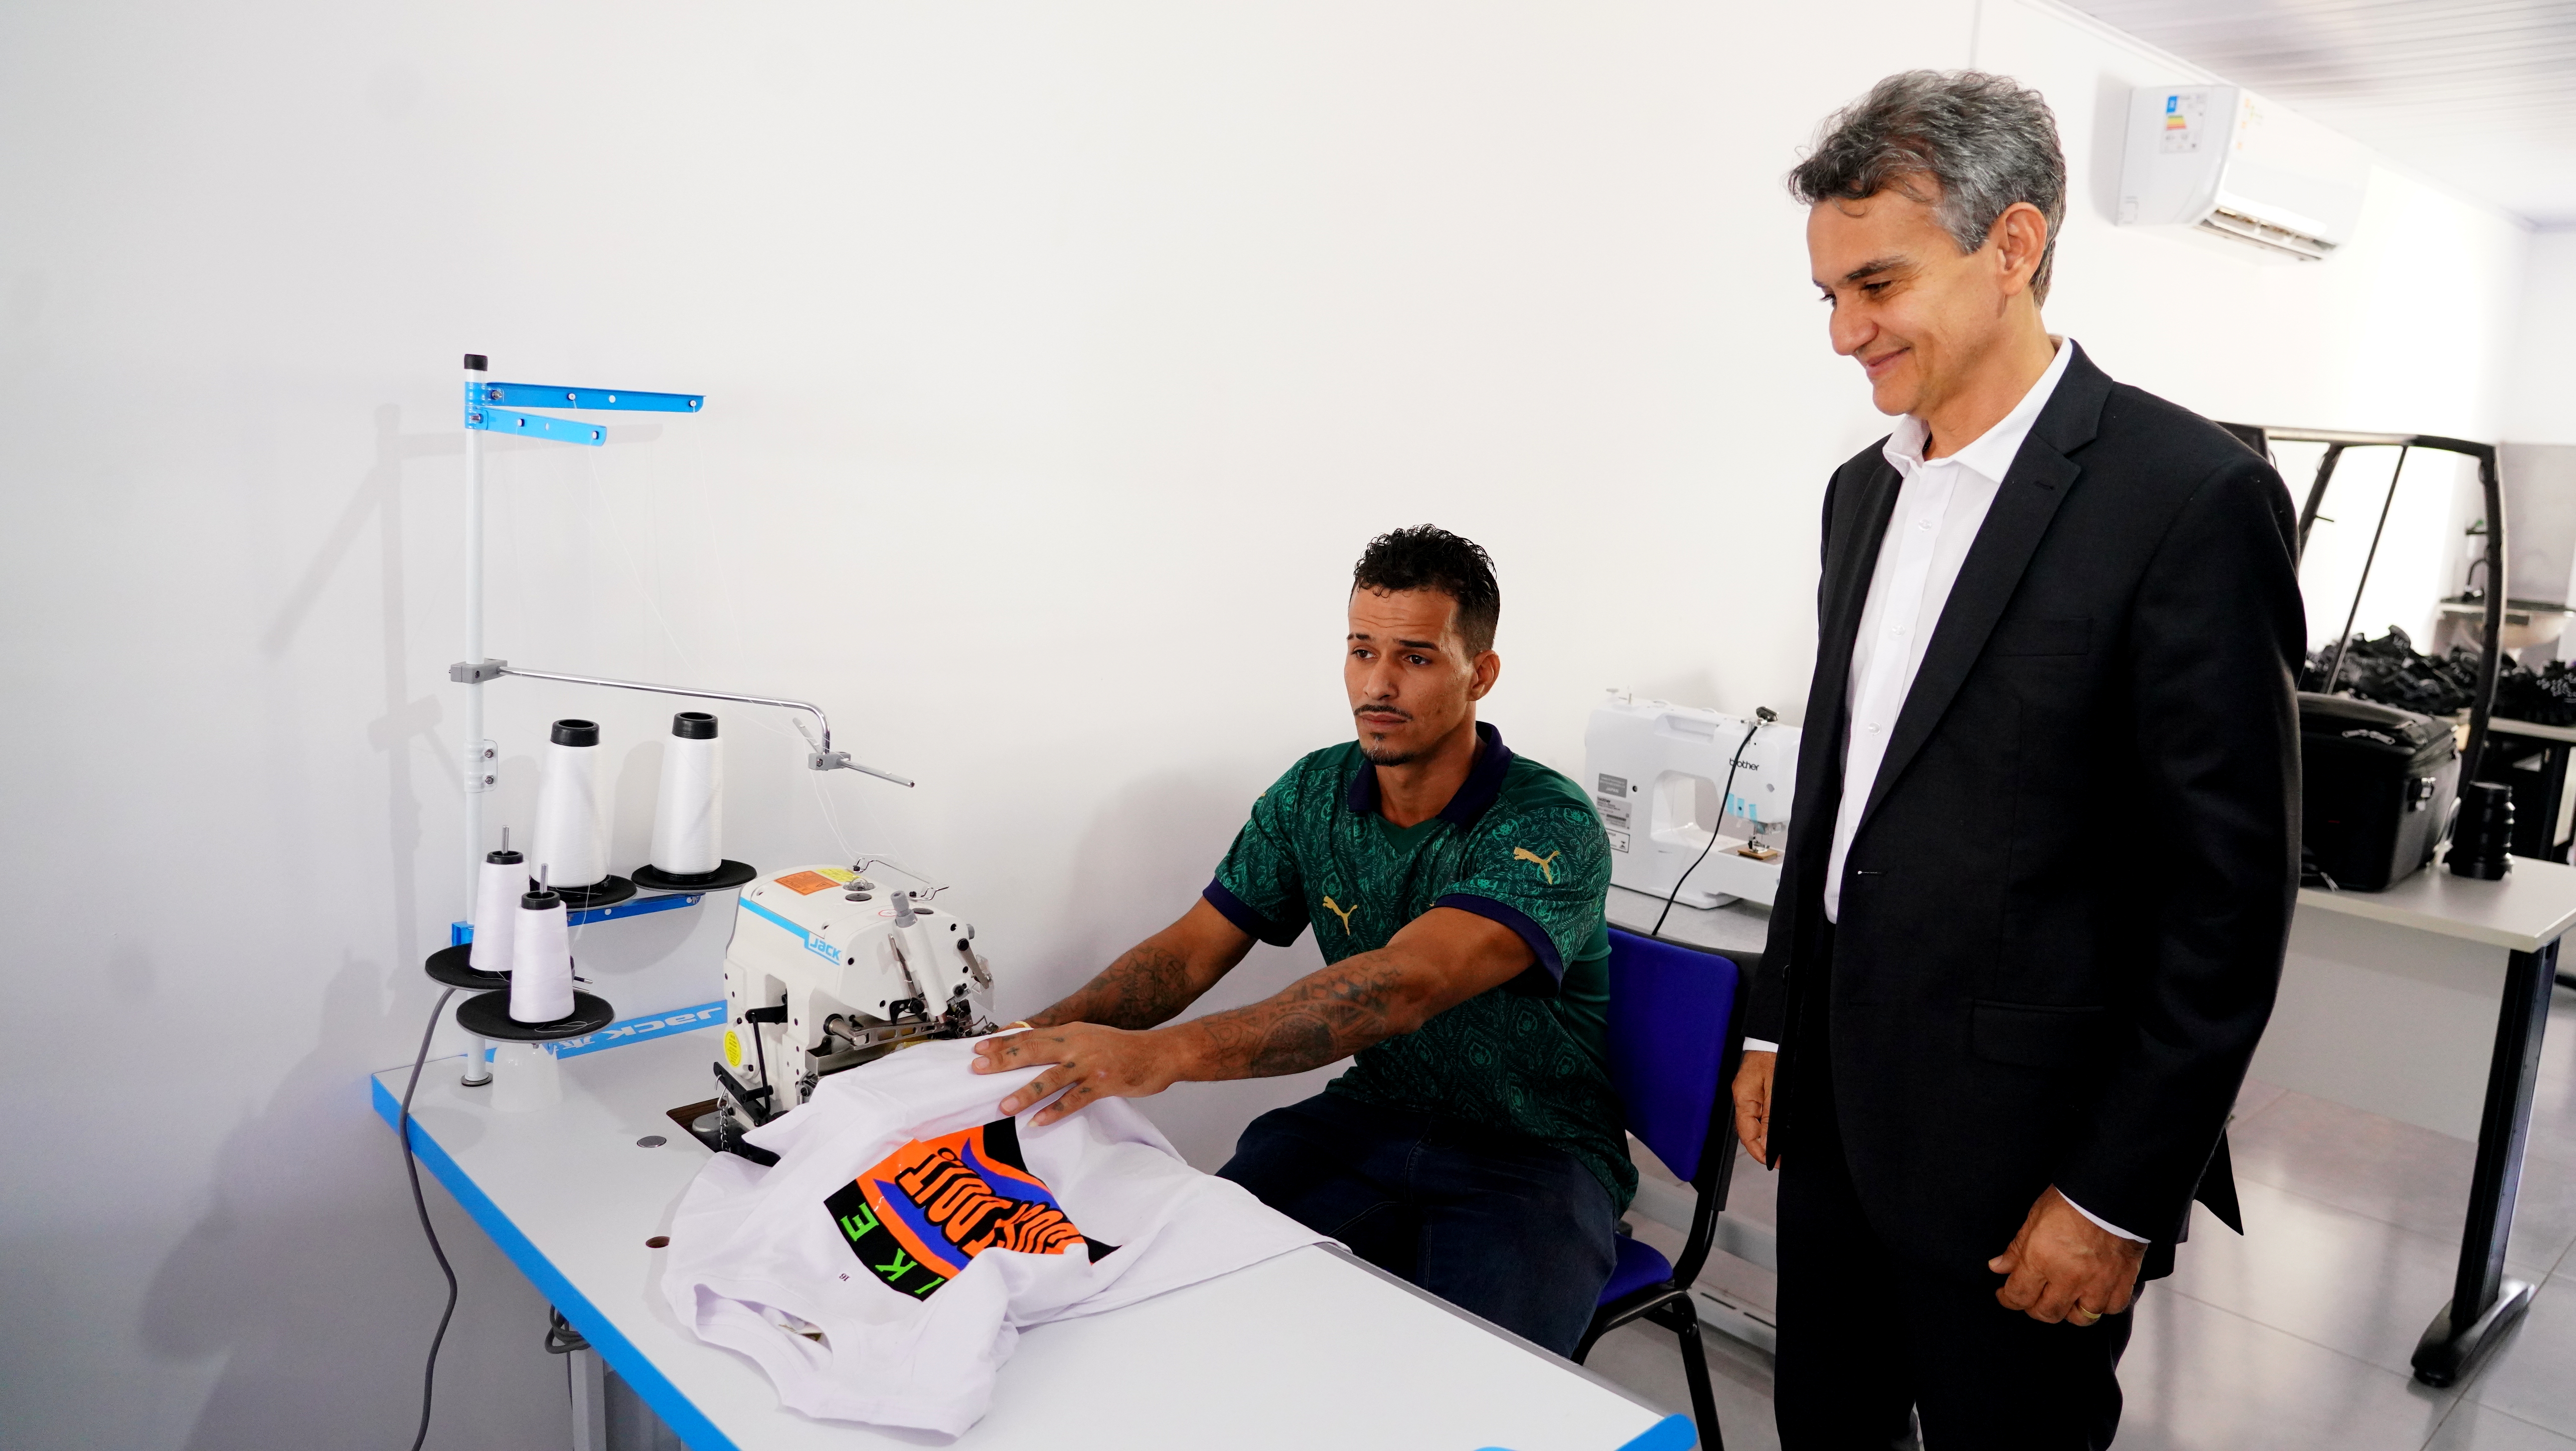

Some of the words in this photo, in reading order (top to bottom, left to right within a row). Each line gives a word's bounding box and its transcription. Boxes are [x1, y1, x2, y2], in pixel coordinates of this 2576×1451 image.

[1729, 757, 1760, 771] bother
[924, 1175, 1015, 1244] DO
[839, 1273, 851, 1282] 16
